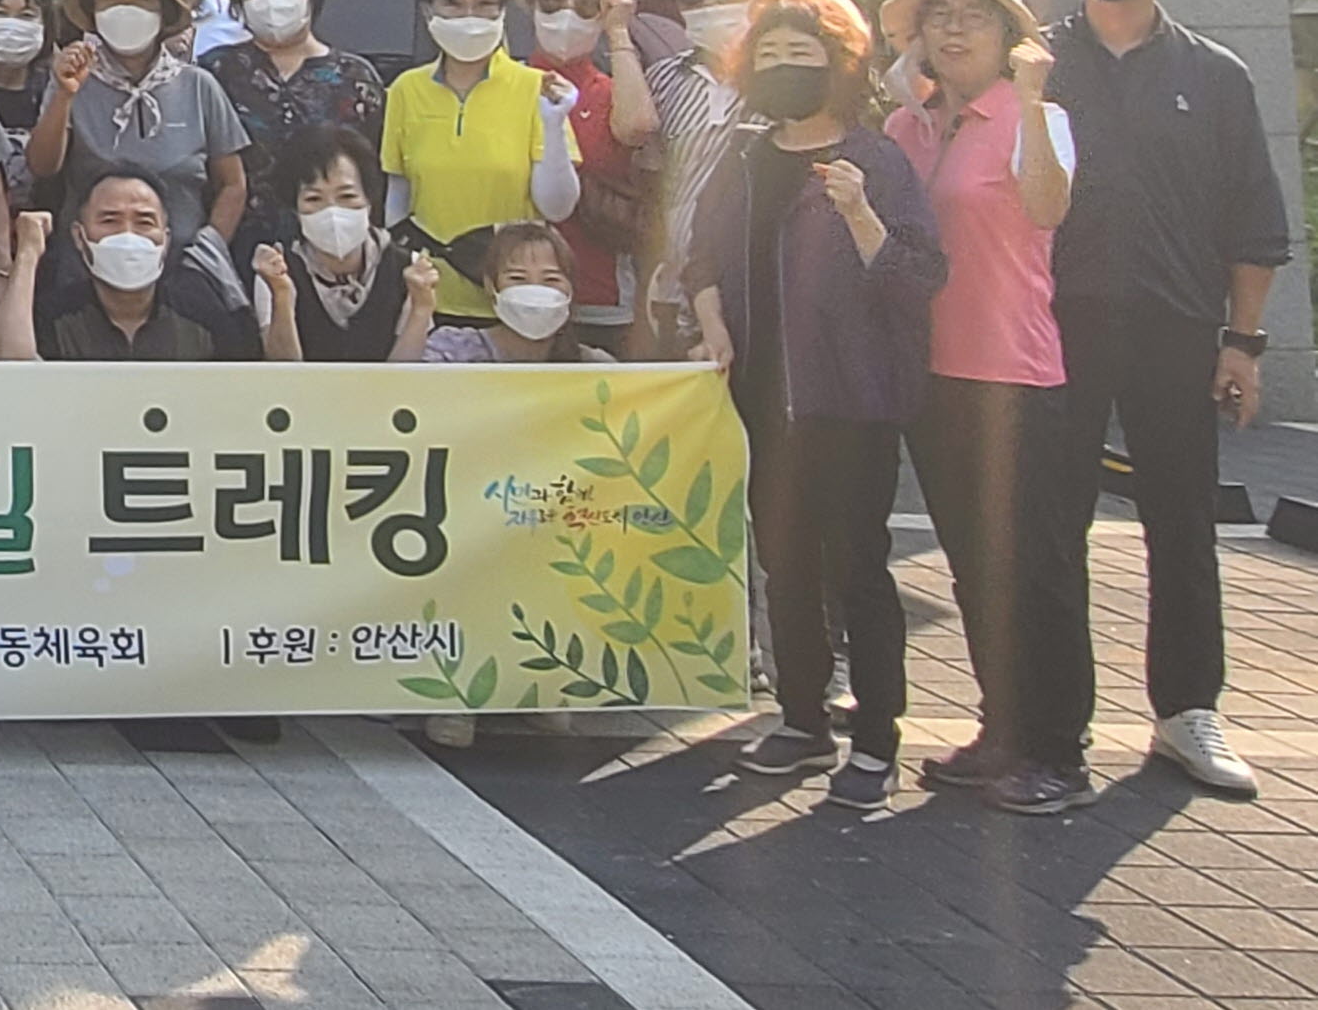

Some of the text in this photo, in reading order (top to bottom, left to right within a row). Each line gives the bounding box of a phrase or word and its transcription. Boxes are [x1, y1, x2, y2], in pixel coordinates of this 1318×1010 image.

[88, 446, 449, 578] 트레킹
[245, 626, 316, 665] 후원
[352, 622, 458, 662] 안산시
